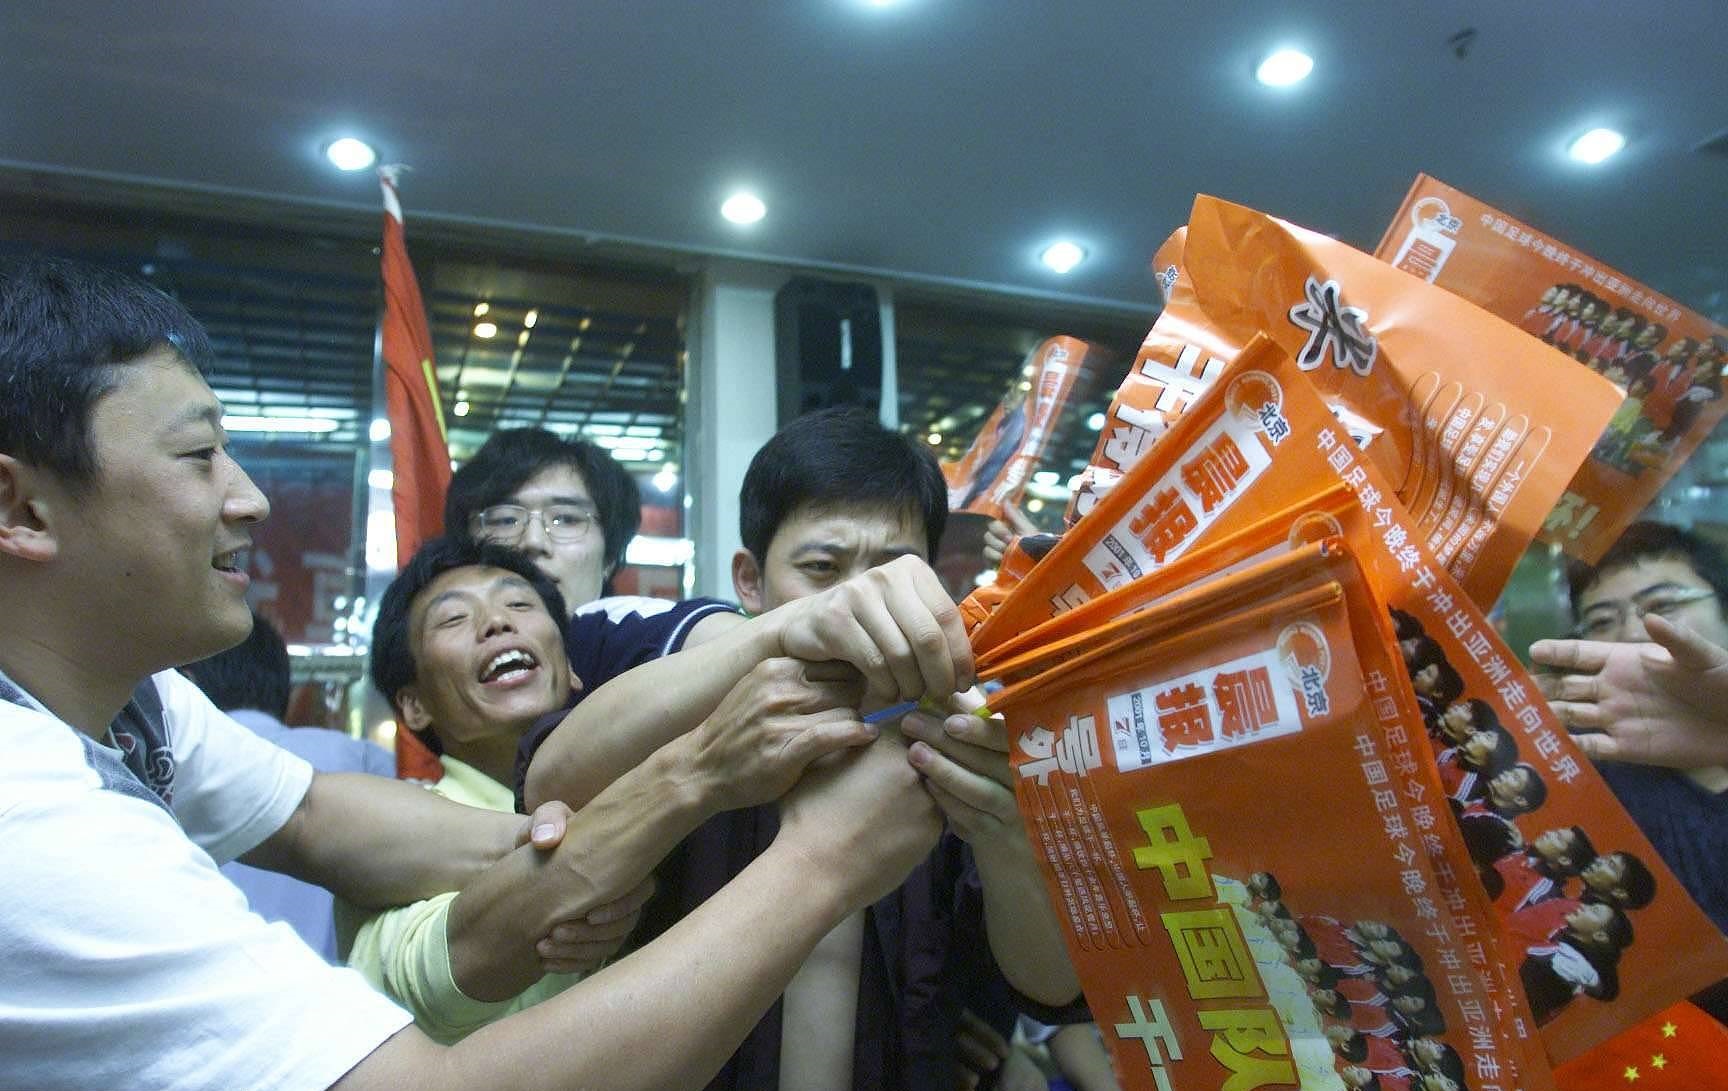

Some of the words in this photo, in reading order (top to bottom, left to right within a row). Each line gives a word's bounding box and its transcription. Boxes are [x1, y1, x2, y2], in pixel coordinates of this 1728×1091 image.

[1259, 401, 1290, 444] 北京
[1128, 430, 1252, 566] 晨报
[1316, 427, 1581, 785] 中国足球今晚终于冲出亚洲走向世界
[1154, 664, 1280, 754] 晨报
[1299, 664, 1329, 718] 北京
[1131, 802, 1298, 1091] 中国队
